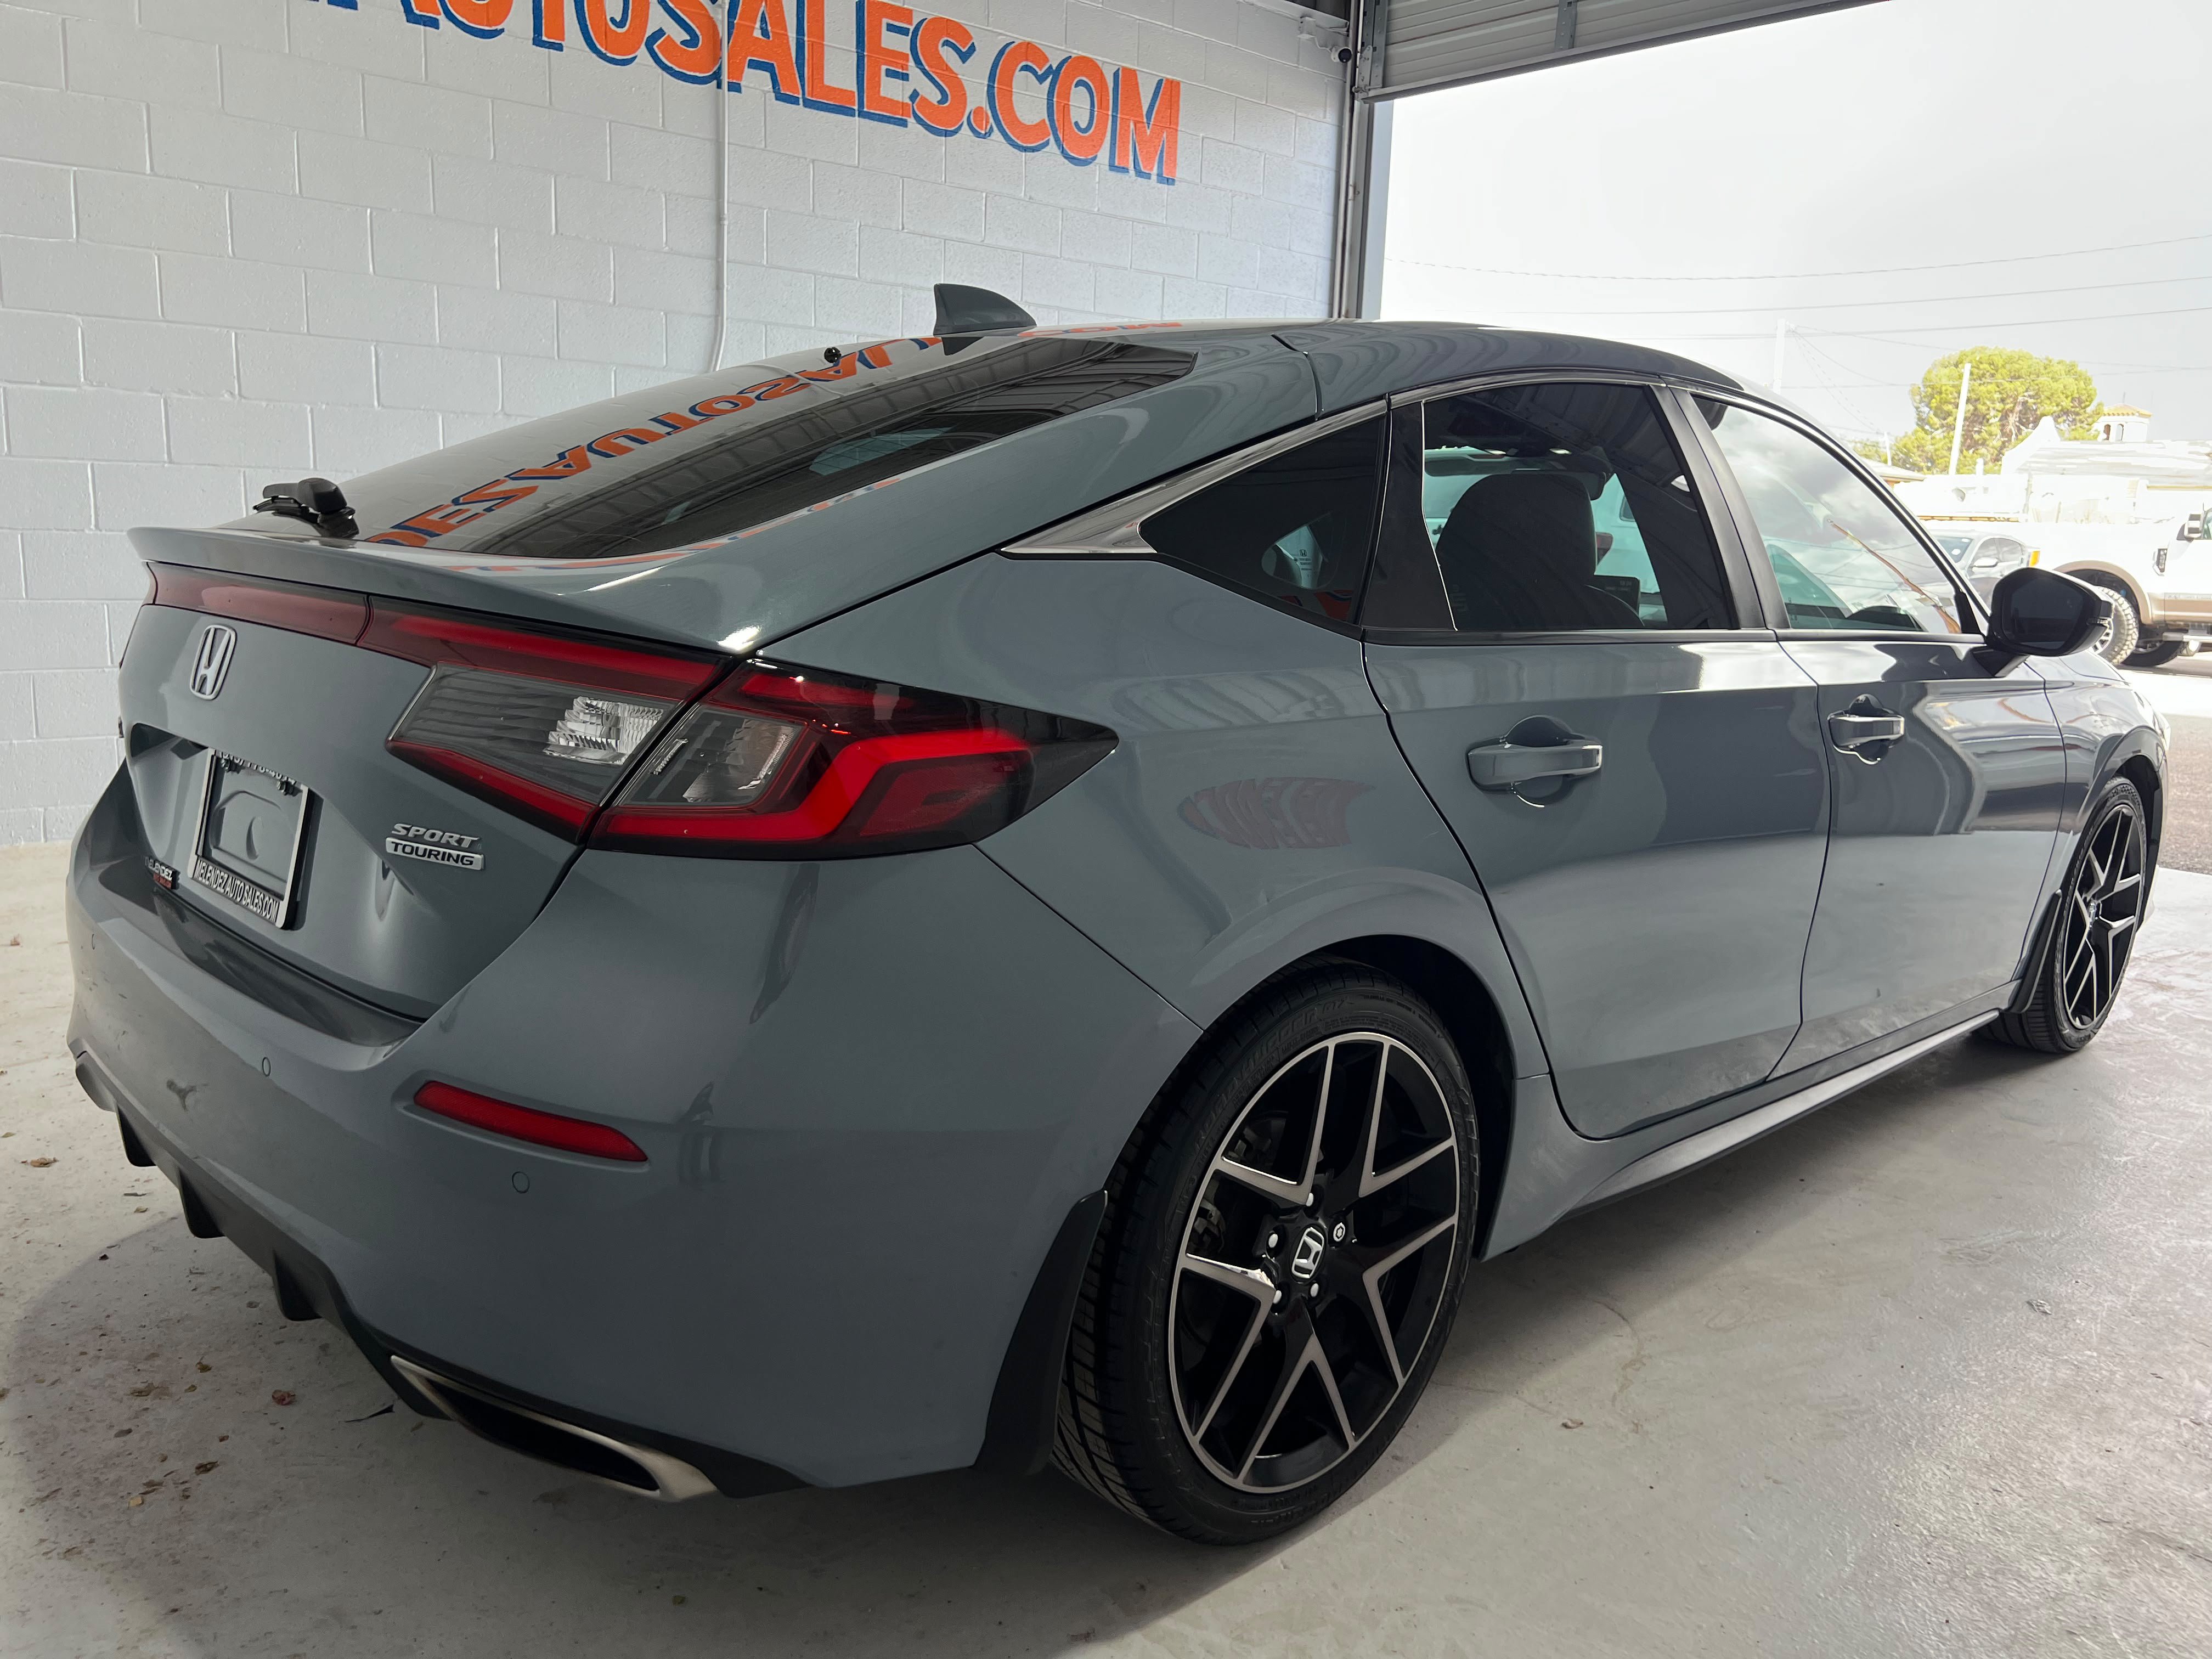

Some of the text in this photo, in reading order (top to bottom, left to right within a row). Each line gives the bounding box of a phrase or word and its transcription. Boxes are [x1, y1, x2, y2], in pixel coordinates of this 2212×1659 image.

[391, 823, 481, 848] SPORT
[391, 841, 475, 866] TOURING
[194, 859, 228, 893] MELENDEZ
[224, 876, 245, 902] AUTO
[242, 884, 281, 923] SALES.COM
